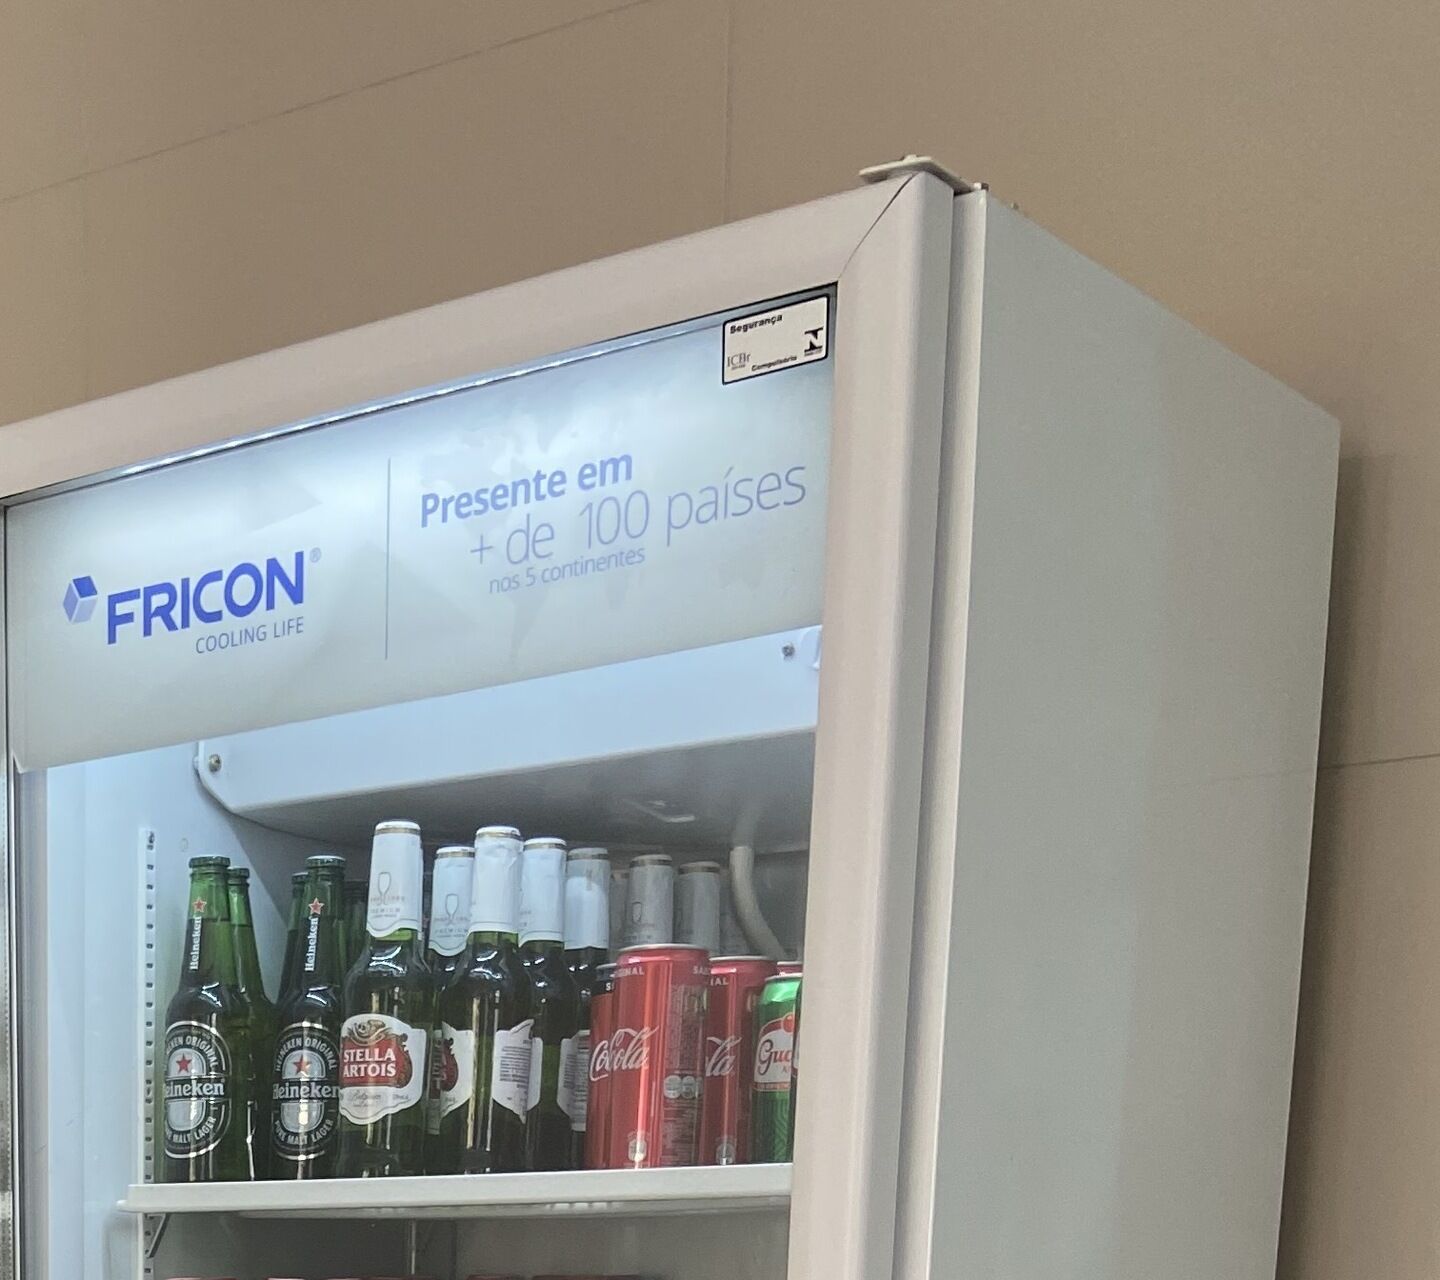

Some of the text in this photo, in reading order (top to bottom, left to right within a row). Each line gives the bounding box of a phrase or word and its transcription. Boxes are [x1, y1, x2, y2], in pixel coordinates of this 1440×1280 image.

[730, 315, 783, 335] Segurança
[421, 453, 633, 528] Presente em
[506, 513, 555, 565] de
[578, 490, 650, 550] 100
[667, 465, 807, 547] países
[489, 546, 646, 593] nos 5 continentes
[107, 550, 304, 645] FRICON
[195, 615, 304, 655] COOLING LIFE
[189, 916, 203, 971] Heineken
[305, 917, 320, 972] Heineken
[185, 1035, 219, 1069] ORIGINAL
[343, 1047, 397, 1062] STELLA
[343, 1063, 397, 1078] ARTOIS
[164, 1079, 225, 1099] eineken
[194, 1115, 217, 1140] LAGER
[311, 1118, 334, 1143] LAGER
